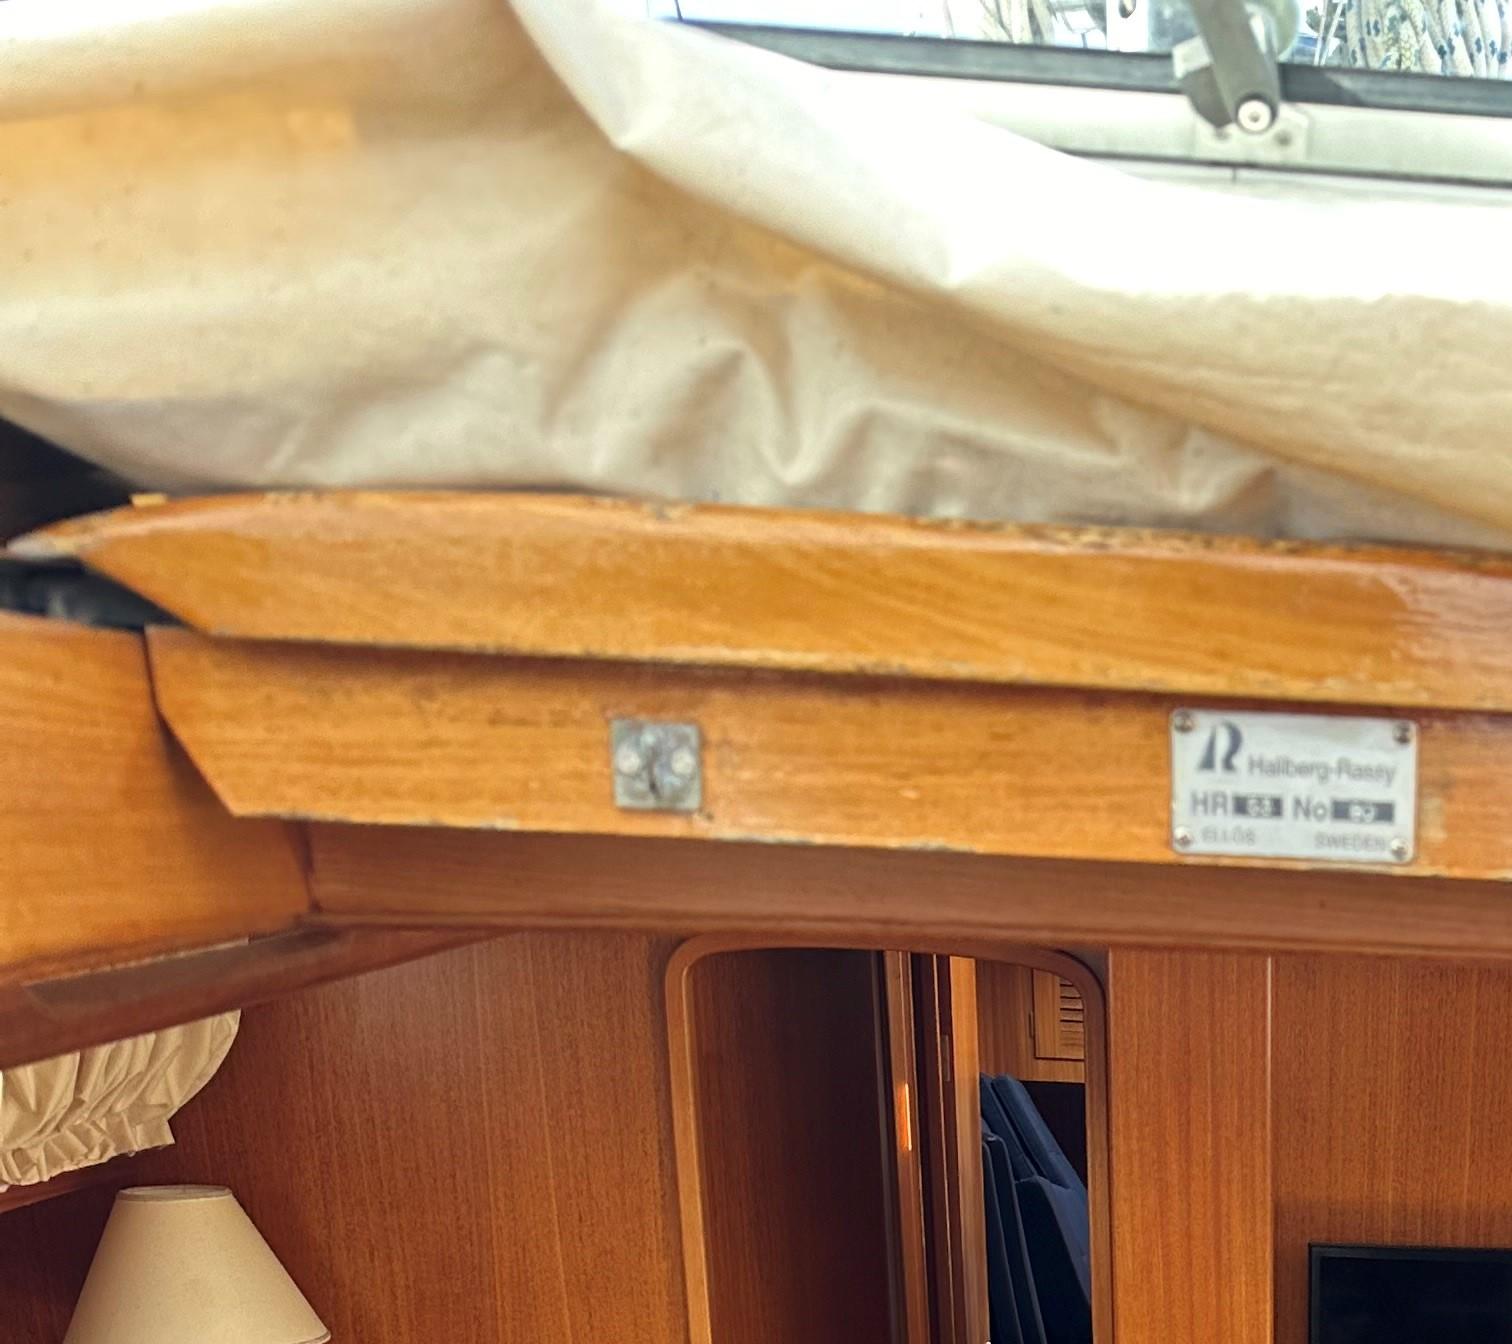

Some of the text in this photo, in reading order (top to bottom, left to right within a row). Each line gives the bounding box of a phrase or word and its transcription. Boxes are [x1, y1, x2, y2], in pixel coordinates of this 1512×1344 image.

[1248, 754, 1396, 787] Hallberg-Rassy
[1191, 790, 1228, 817] HR
[1293, 796, 1328, 821] No
